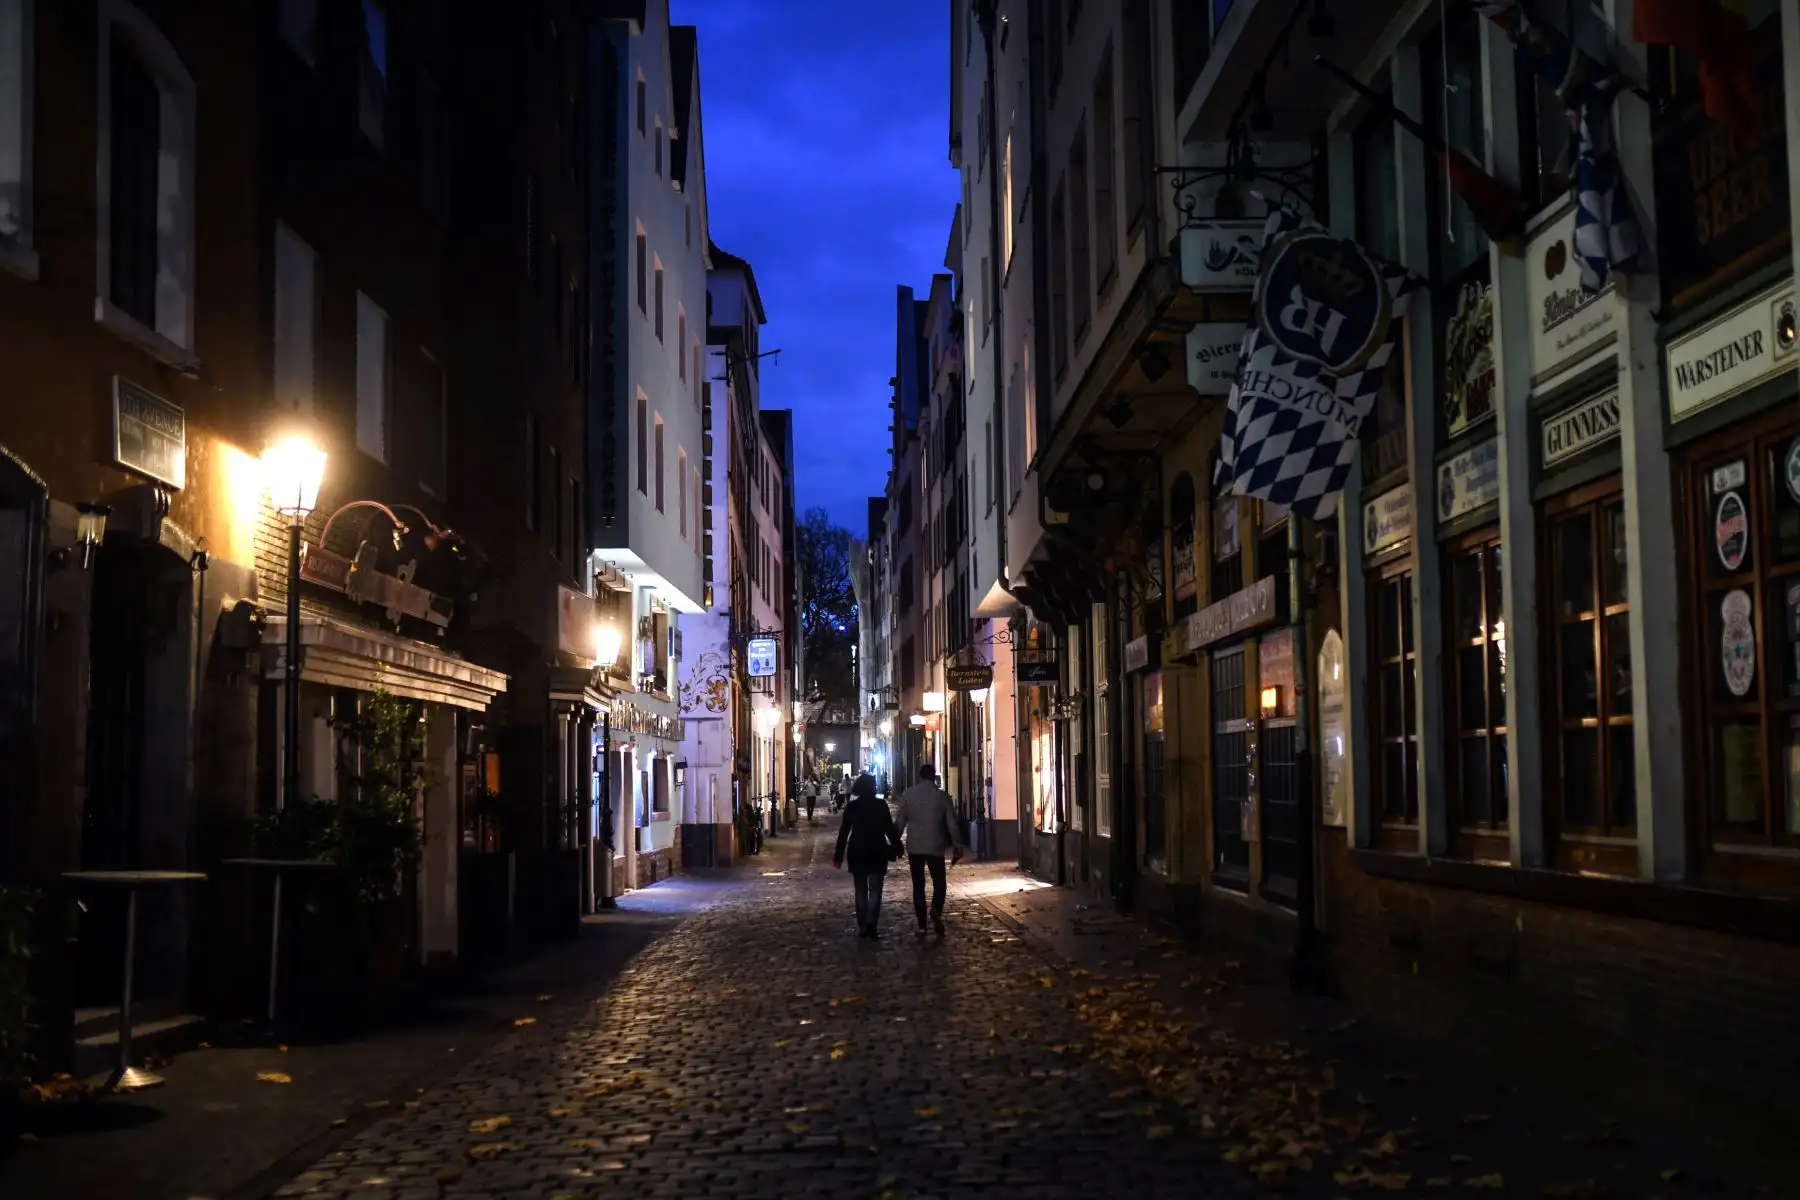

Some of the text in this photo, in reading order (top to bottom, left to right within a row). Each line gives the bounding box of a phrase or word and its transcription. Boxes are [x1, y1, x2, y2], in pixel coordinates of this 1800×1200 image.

[1675, 330, 1764, 392] WARSTEINER
[1548, 396, 1620, 454] GUINNESS
[951, 668, 989, 678] Bernstein
